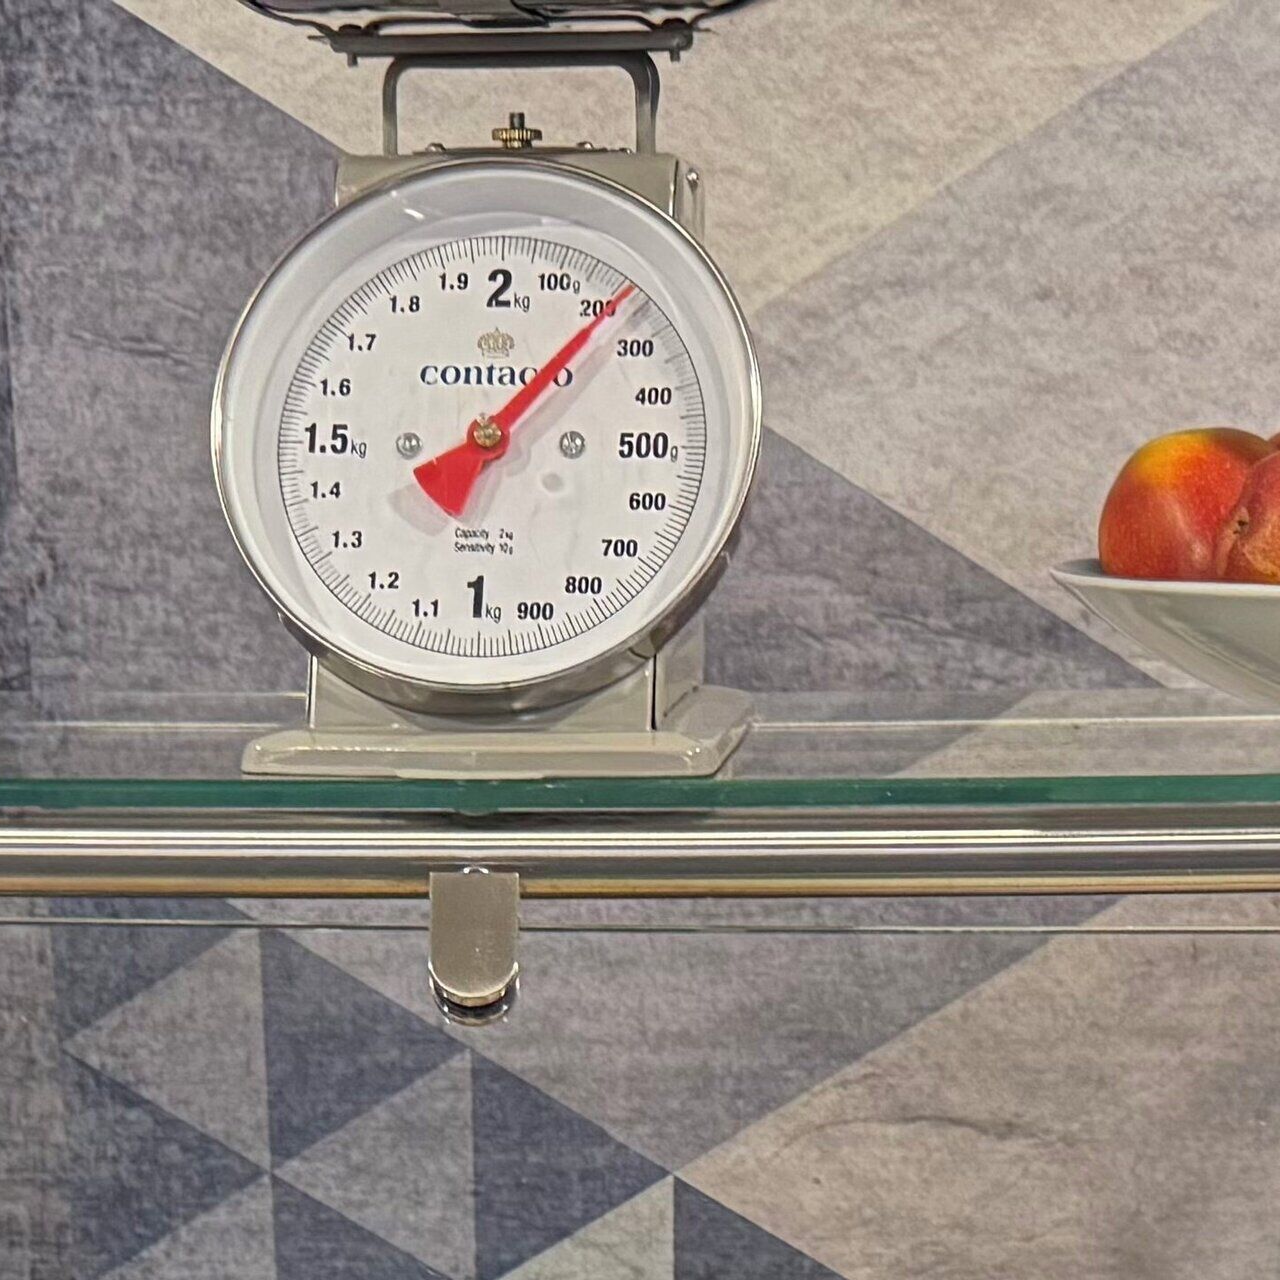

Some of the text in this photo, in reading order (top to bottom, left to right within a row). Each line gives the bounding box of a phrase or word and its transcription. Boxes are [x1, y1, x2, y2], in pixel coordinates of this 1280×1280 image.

[438, 273, 469, 291] 1.9
[389, 295, 421, 314] 1.8
[348, 333, 377, 352] 1.7
[616, 339, 655, 357] 300
[419, 363, 574, 388] contaco
[320, 378, 351, 397] 1.6
[635, 387, 672, 405] 400
[310, 480, 342, 499] 1.4
[628, 492, 667, 511] 600
[332, 530, 363, 549] 1.3
[601, 538, 639, 557] 700
[368, 571, 400, 590] 1.2
[564, 576, 603, 595] 800
[412, 598, 439, 617] 1.1
[516, 601, 554, 620] 900
